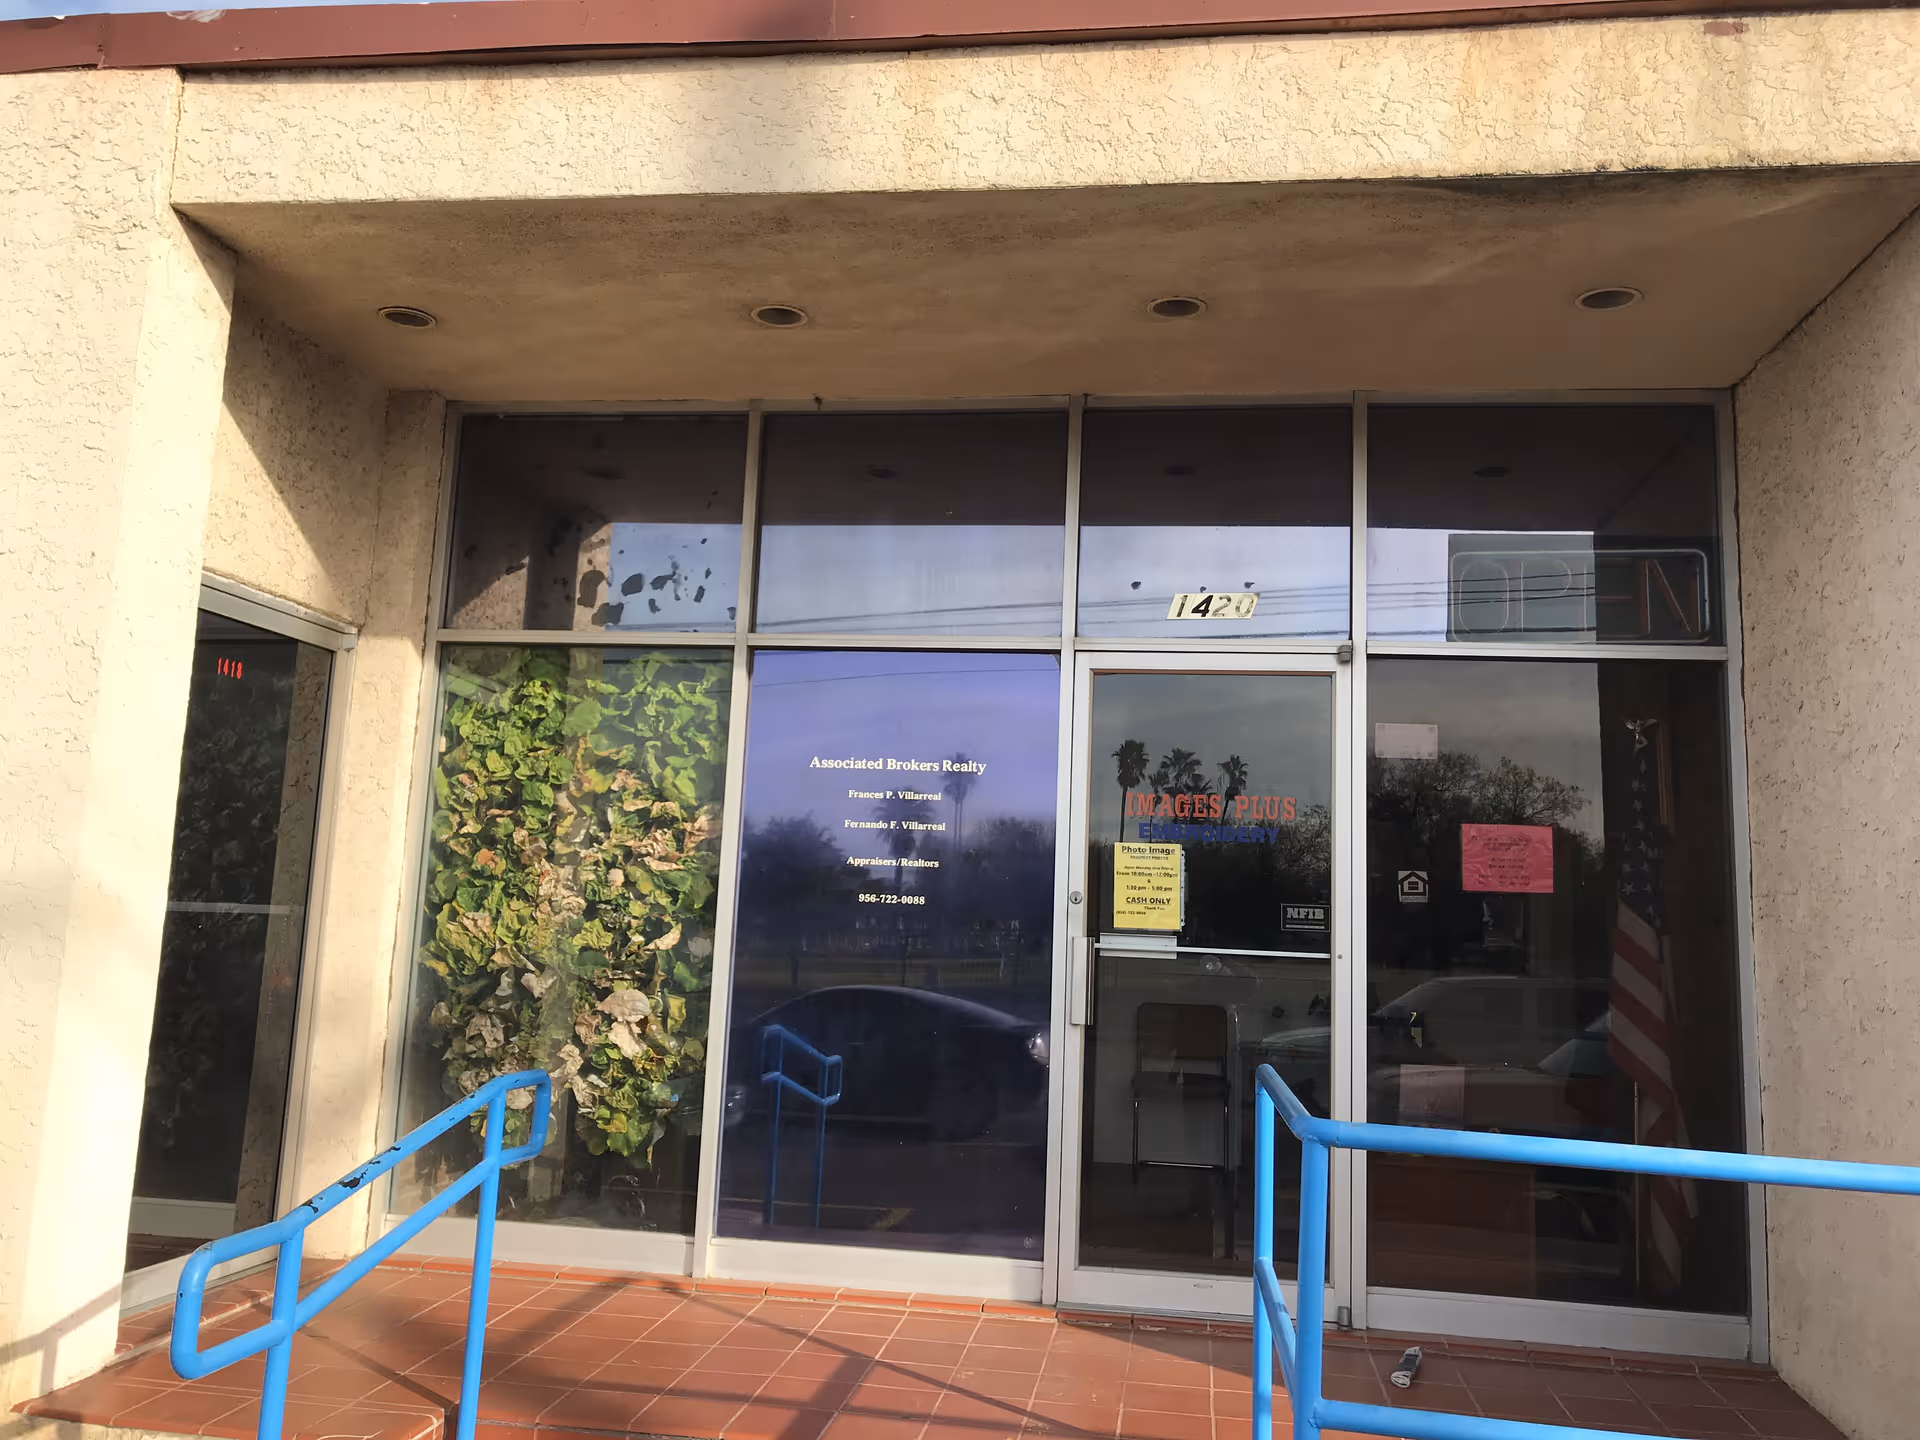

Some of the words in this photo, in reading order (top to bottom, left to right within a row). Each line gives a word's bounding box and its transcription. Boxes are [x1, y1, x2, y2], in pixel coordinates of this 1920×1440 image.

[1176, 594, 1254, 618] 1420
[217, 657, 243, 680] 1418
[809, 756, 883, 770] Associated
[886, 758, 940, 772] Brokers
[942, 759, 987, 775] Realty
[848, 789, 884, 799] Frances
[886, 790, 895, 800] P.
[897, 791, 942, 801] Villarreal
[1126, 792, 1222, 819] IMAGES
[1234, 795, 1297, 821] PLUS
[844, 819, 888, 830] Fernando
[890, 820, 899, 830] F.
[901, 821, 946, 831] Villarreal
[1138, 822, 1281, 844] EMBROIDERY
[1121, 845, 1147, 854] Photo
[1149, 846, 1176, 856] Image
[846, 856, 939, 868] Appraisers/Realtors
[858, 894, 926, 905] 956-722-0088
[1126, 896, 1147, 904] CASH
[1149, 897, 1171, 905] ONLY
[1286, 907, 1325, 919] NFIB
